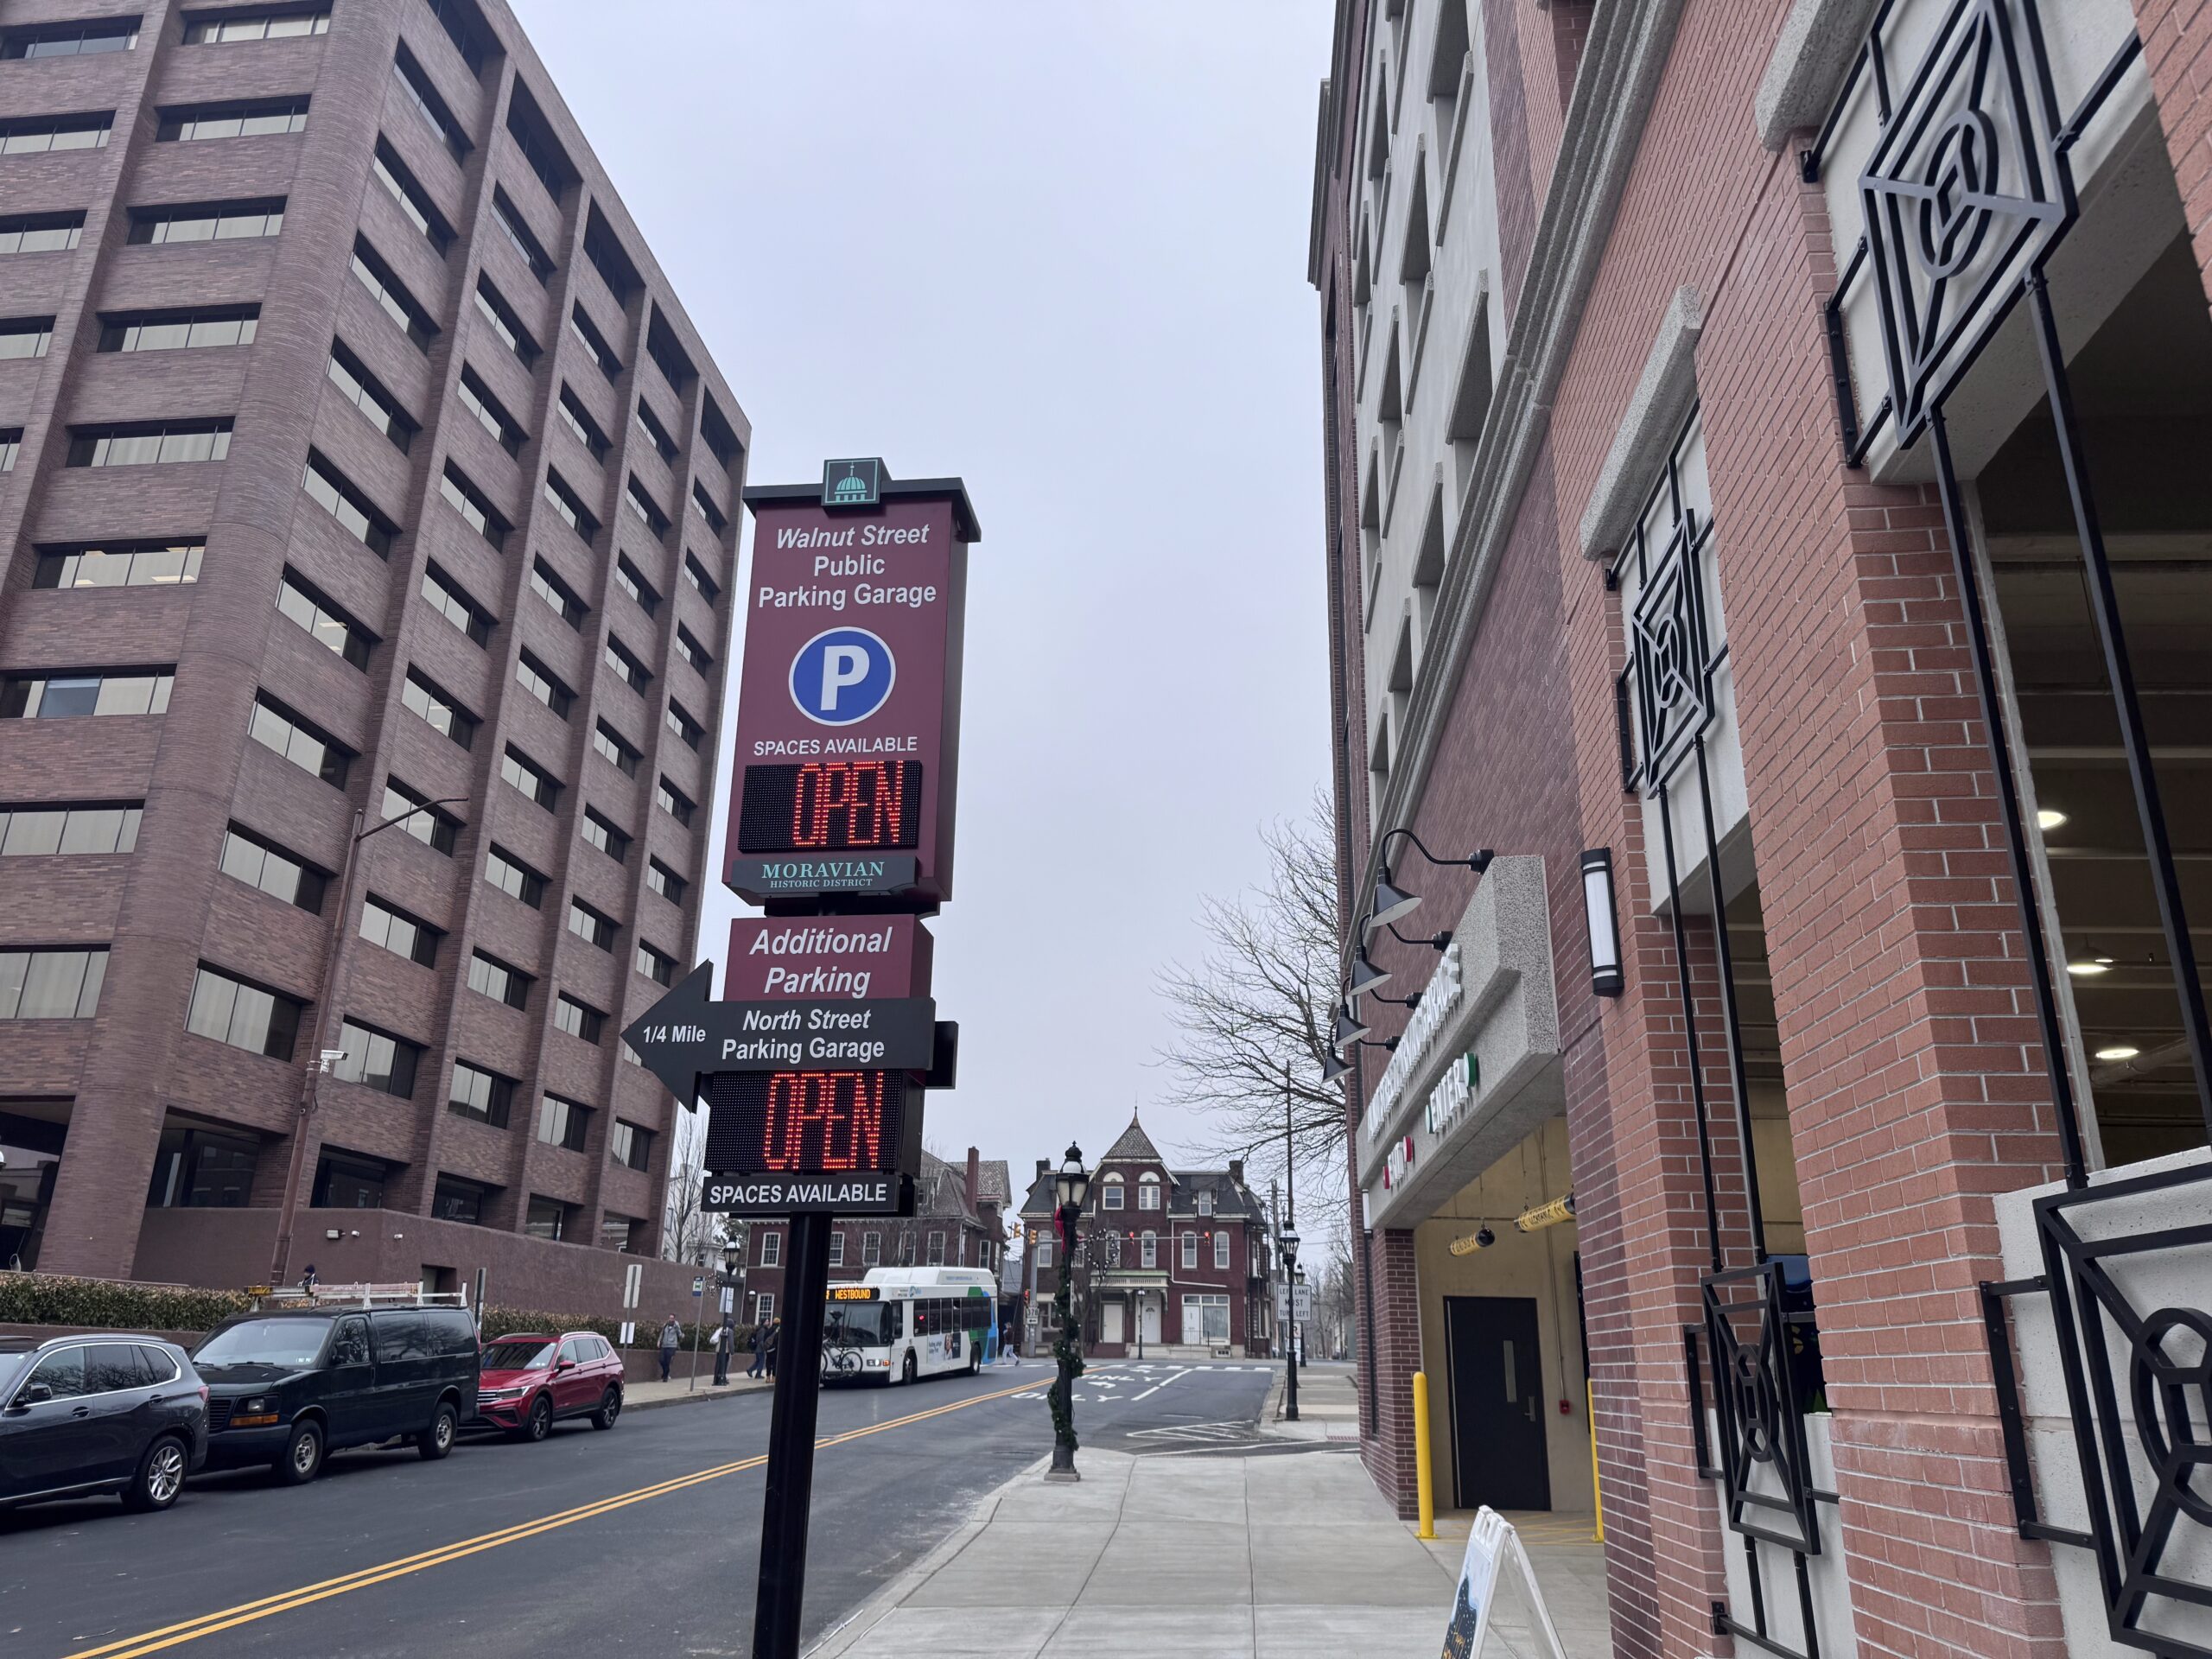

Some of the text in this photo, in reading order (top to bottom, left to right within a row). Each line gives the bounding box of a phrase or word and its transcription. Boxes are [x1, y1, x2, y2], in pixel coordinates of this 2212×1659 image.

[777, 524, 930, 549] Walnut Street
[814, 554, 886, 576] Public
[758, 583, 937, 611] Parking Garage
[821, 645, 870, 710] P
[753, 736, 918, 756] SPACES AVAILABLE
[793, 760, 904, 845] OPEN
[761, 861, 886, 879] MORAVIAN
[770, 878, 873, 888] HISTORIC DISTRICT
[749, 926, 893, 955] Additional
[764, 966, 871, 999] Parking
[742, 1008, 872, 1031] North Street
[643, 1025, 706, 1043] 1/4 Mile
[721, 1037, 885, 1064] Parking Garage
[1430, 1058, 1468, 1132] ENTER
[764, 1072, 883, 1169] OPEN
[709, 1183, 887, 1204] SPACES AVAILABLE
[835, 1288, 871, 1300] WESTBOUND
